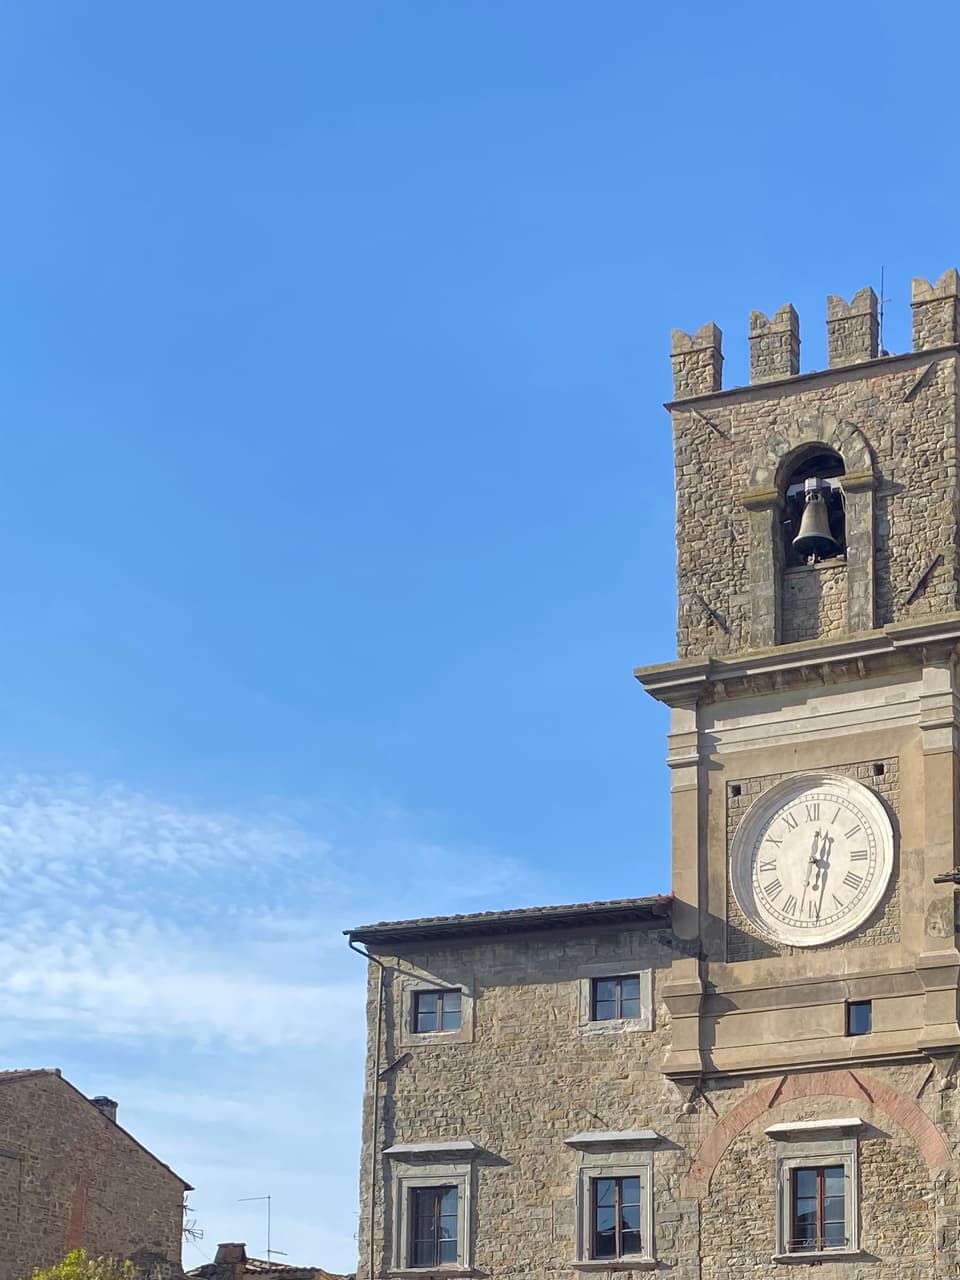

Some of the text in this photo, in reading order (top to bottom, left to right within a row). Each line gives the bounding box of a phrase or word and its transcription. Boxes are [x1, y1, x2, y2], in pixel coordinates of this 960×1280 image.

[805, 803, 820, 823] XII
[831, 807, 841, 824] I
[782, 812, 799, 833] XI
[844, 824, 862, 840] II
[765, 834, 783, 848] X
[850, 850, 868, 862] III
[760, 859, 776, 872] IX
[764, 878, 783, 902] VIII
[781, 895, 798, 917] VII
[832, 894, 844, 910] V
